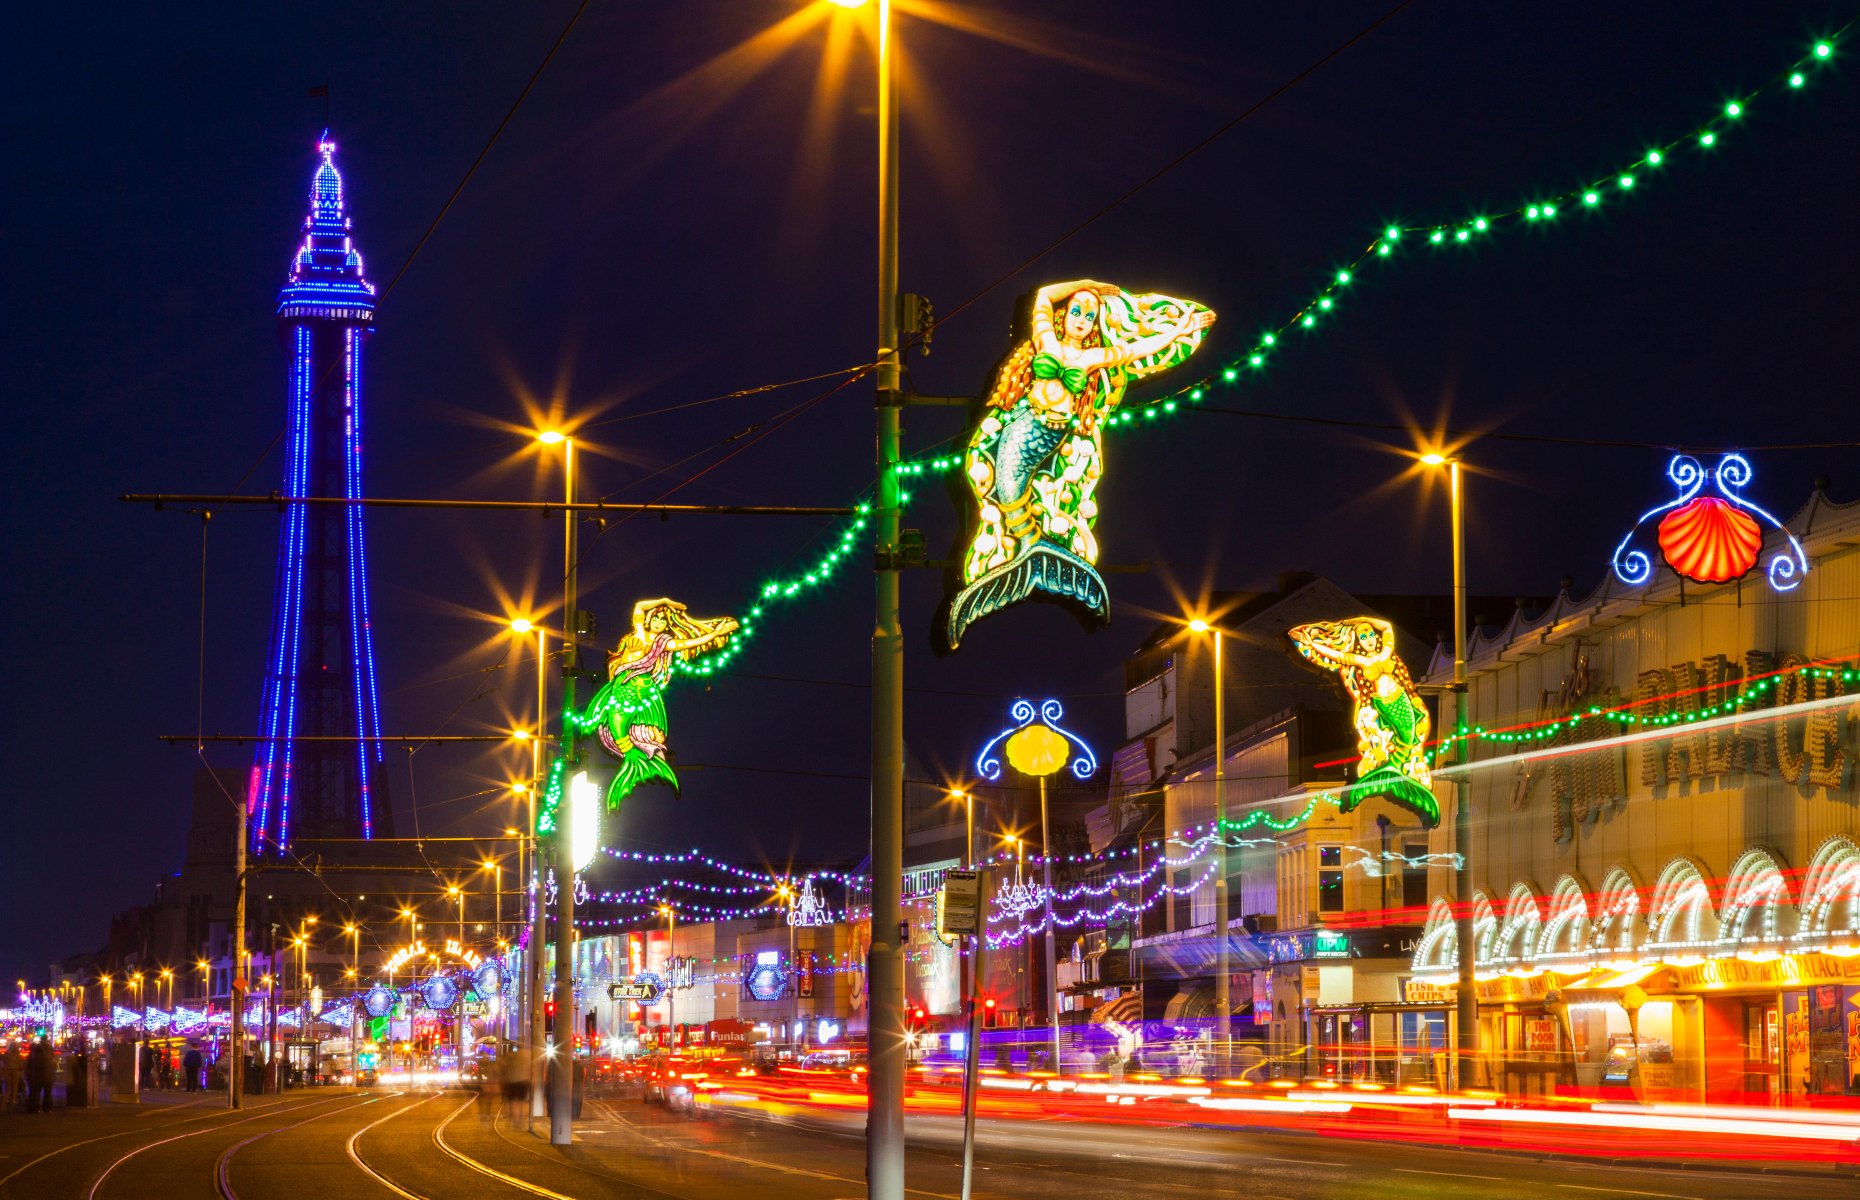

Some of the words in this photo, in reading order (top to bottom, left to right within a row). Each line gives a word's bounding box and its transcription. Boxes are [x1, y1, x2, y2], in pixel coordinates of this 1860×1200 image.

[1638, 648, 1846, 794] PALACE
[1682, 960, 1731, 985] WELCOME
[1735, 961, 1748, 983] TO
[1408, 982, 1435, 992] FISH
[1411, 991, 1444, 1001] CHIPS
[1534, 1021, 1551, 1032] THIS
[1531, 1033, 1554, 1043] DOOR
